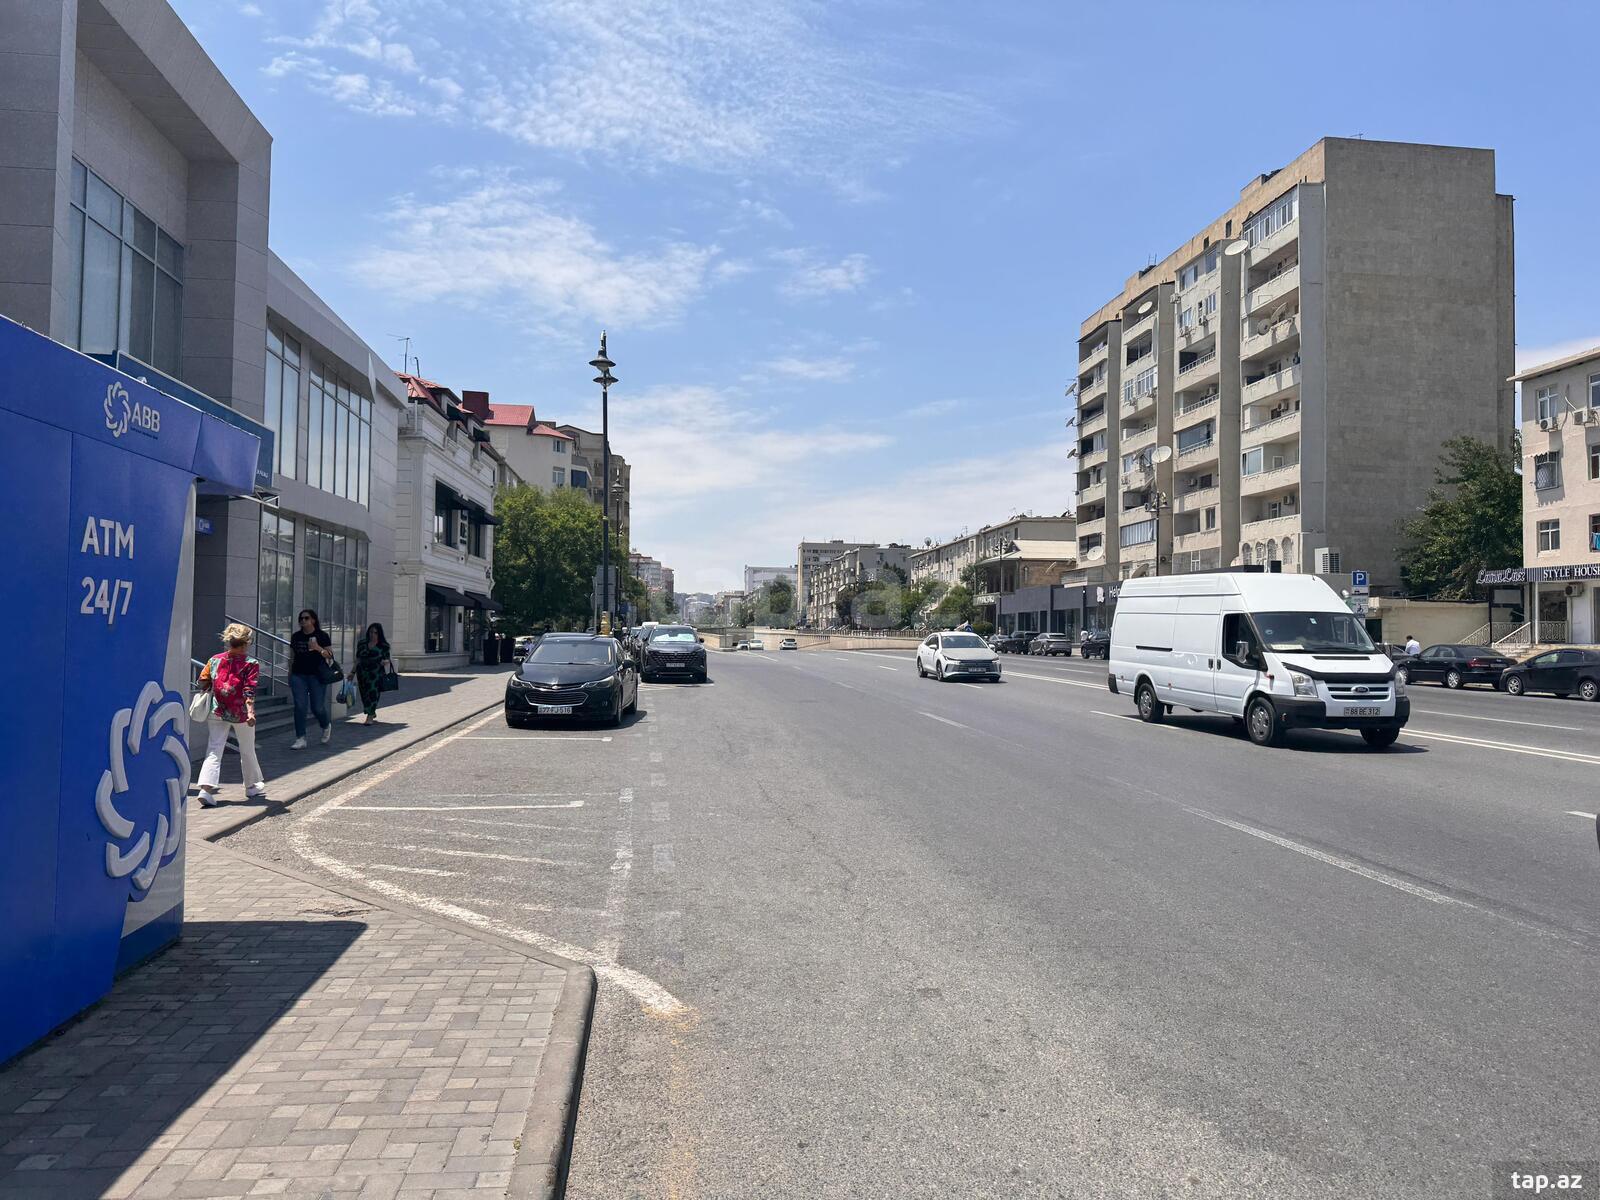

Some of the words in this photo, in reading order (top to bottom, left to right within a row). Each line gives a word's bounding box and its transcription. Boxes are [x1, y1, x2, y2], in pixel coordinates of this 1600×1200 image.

[131, 402, 160, 432] ABB
[80, 516, 134, 560] ATM
[1356, 573, 1365, 584] P
[1543, 569, 1570, 579] STYLE
[80, 576, 133, 625] 24/7
